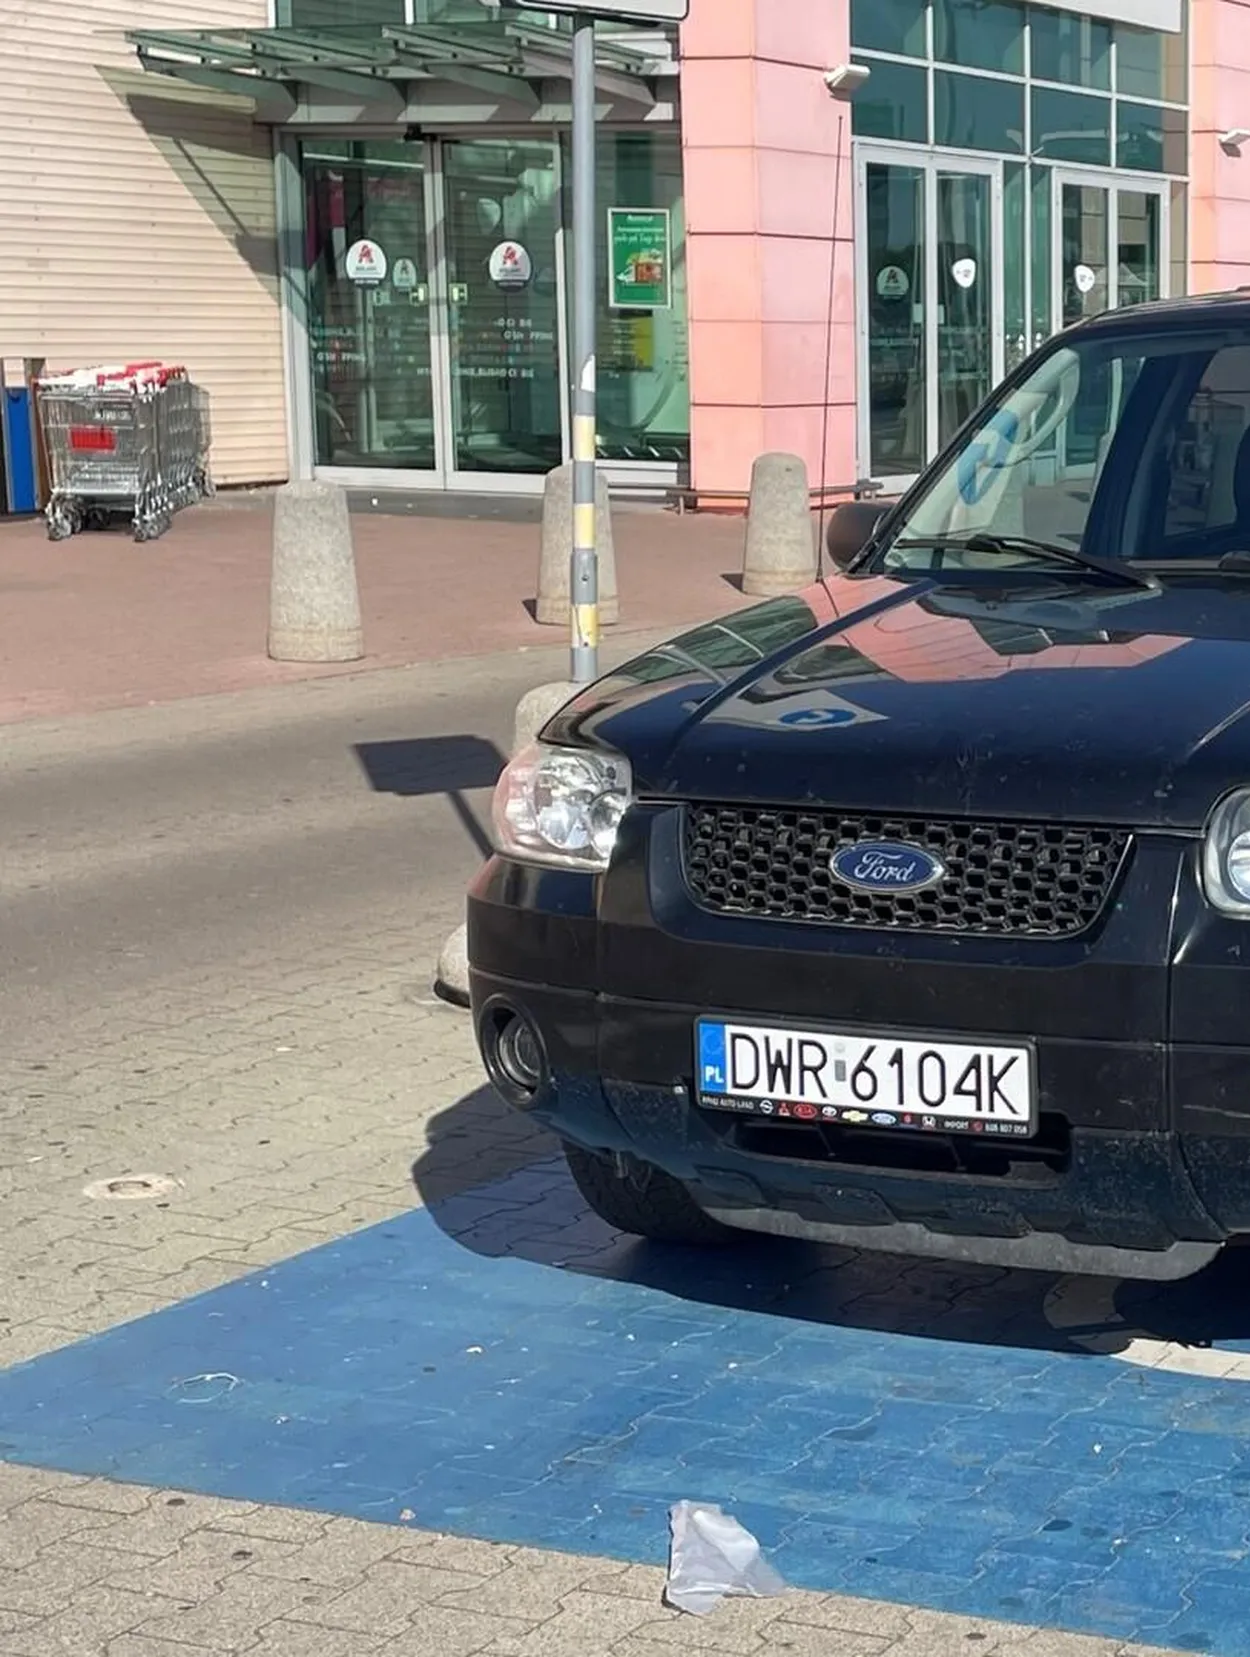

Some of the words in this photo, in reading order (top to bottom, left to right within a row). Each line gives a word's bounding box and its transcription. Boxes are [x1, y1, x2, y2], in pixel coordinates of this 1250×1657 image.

[853, 850, 917, 882] Ford
[703, 1064, 725, 1085] PL
[729, 1031, 828, 1099] DWR
[850, 1045, 1021, 1115] 6104K
